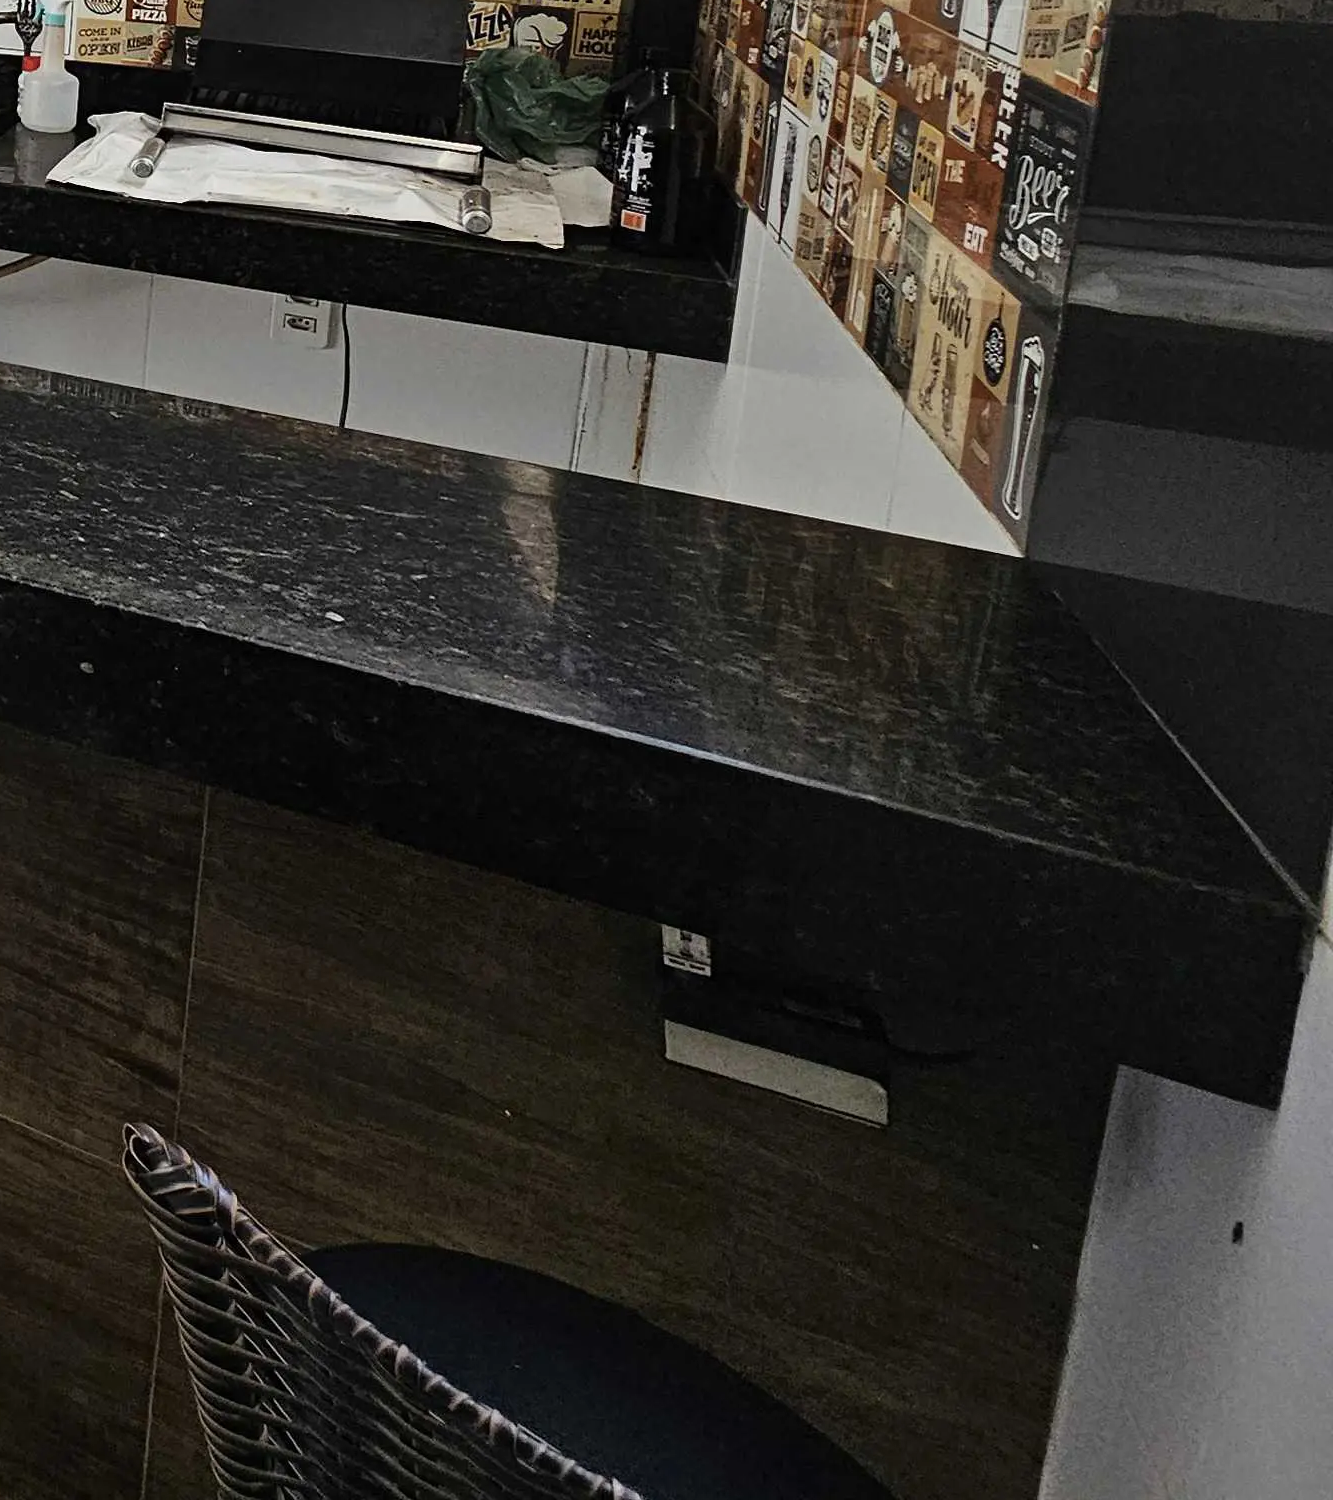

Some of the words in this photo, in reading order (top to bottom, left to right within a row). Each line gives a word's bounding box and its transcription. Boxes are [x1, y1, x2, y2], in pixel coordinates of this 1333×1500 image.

[132, 8, 168, 22] PIZZA
[78, 27, 109, 37] COME
[110, 26, 122, 36] IN
[78, 42, 122, 57] OPEN
[1008, 154, 1072, 231] Beer
[963, 222, 988, 254] EAT
